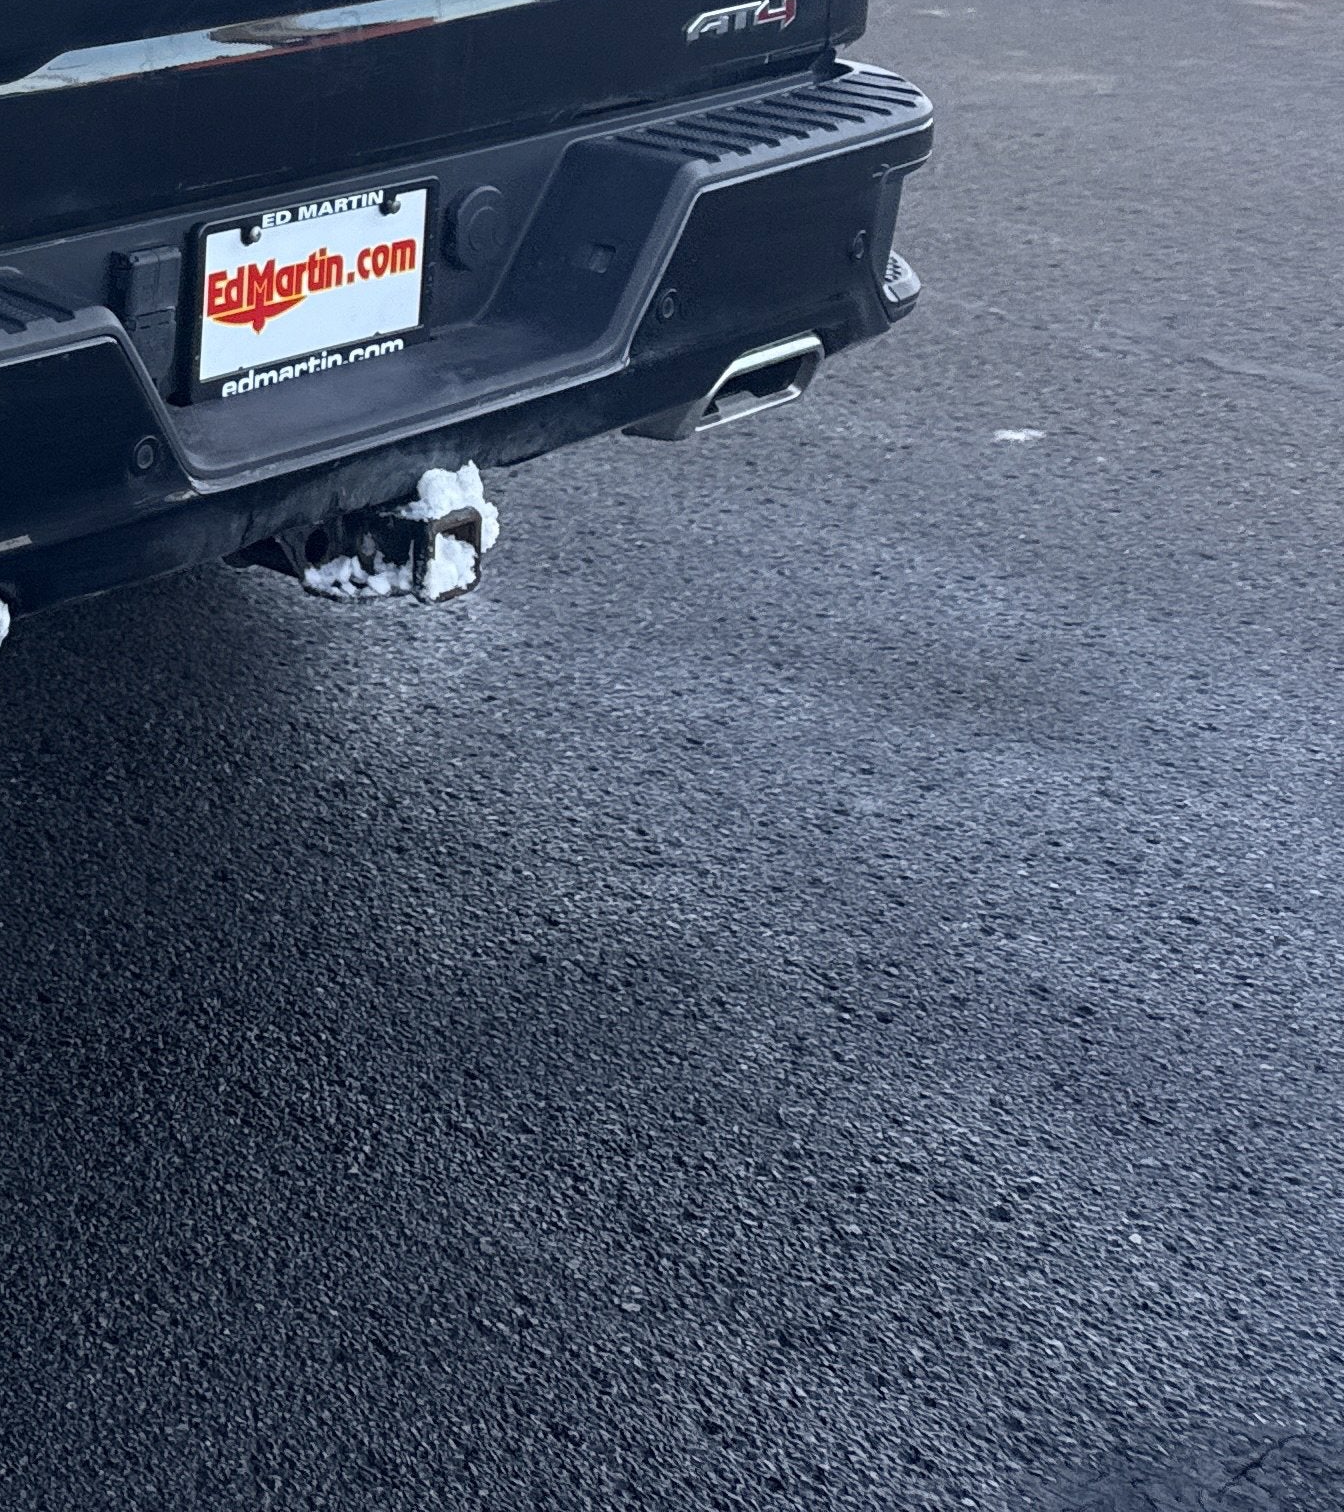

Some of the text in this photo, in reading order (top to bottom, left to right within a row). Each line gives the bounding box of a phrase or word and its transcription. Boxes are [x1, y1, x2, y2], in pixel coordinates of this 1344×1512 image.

[261, 189, 385, 229] ED MARTIN
[206, 238, 417, 334] EdMartin.com
[221, 337, 405, 398] edmartin.com
